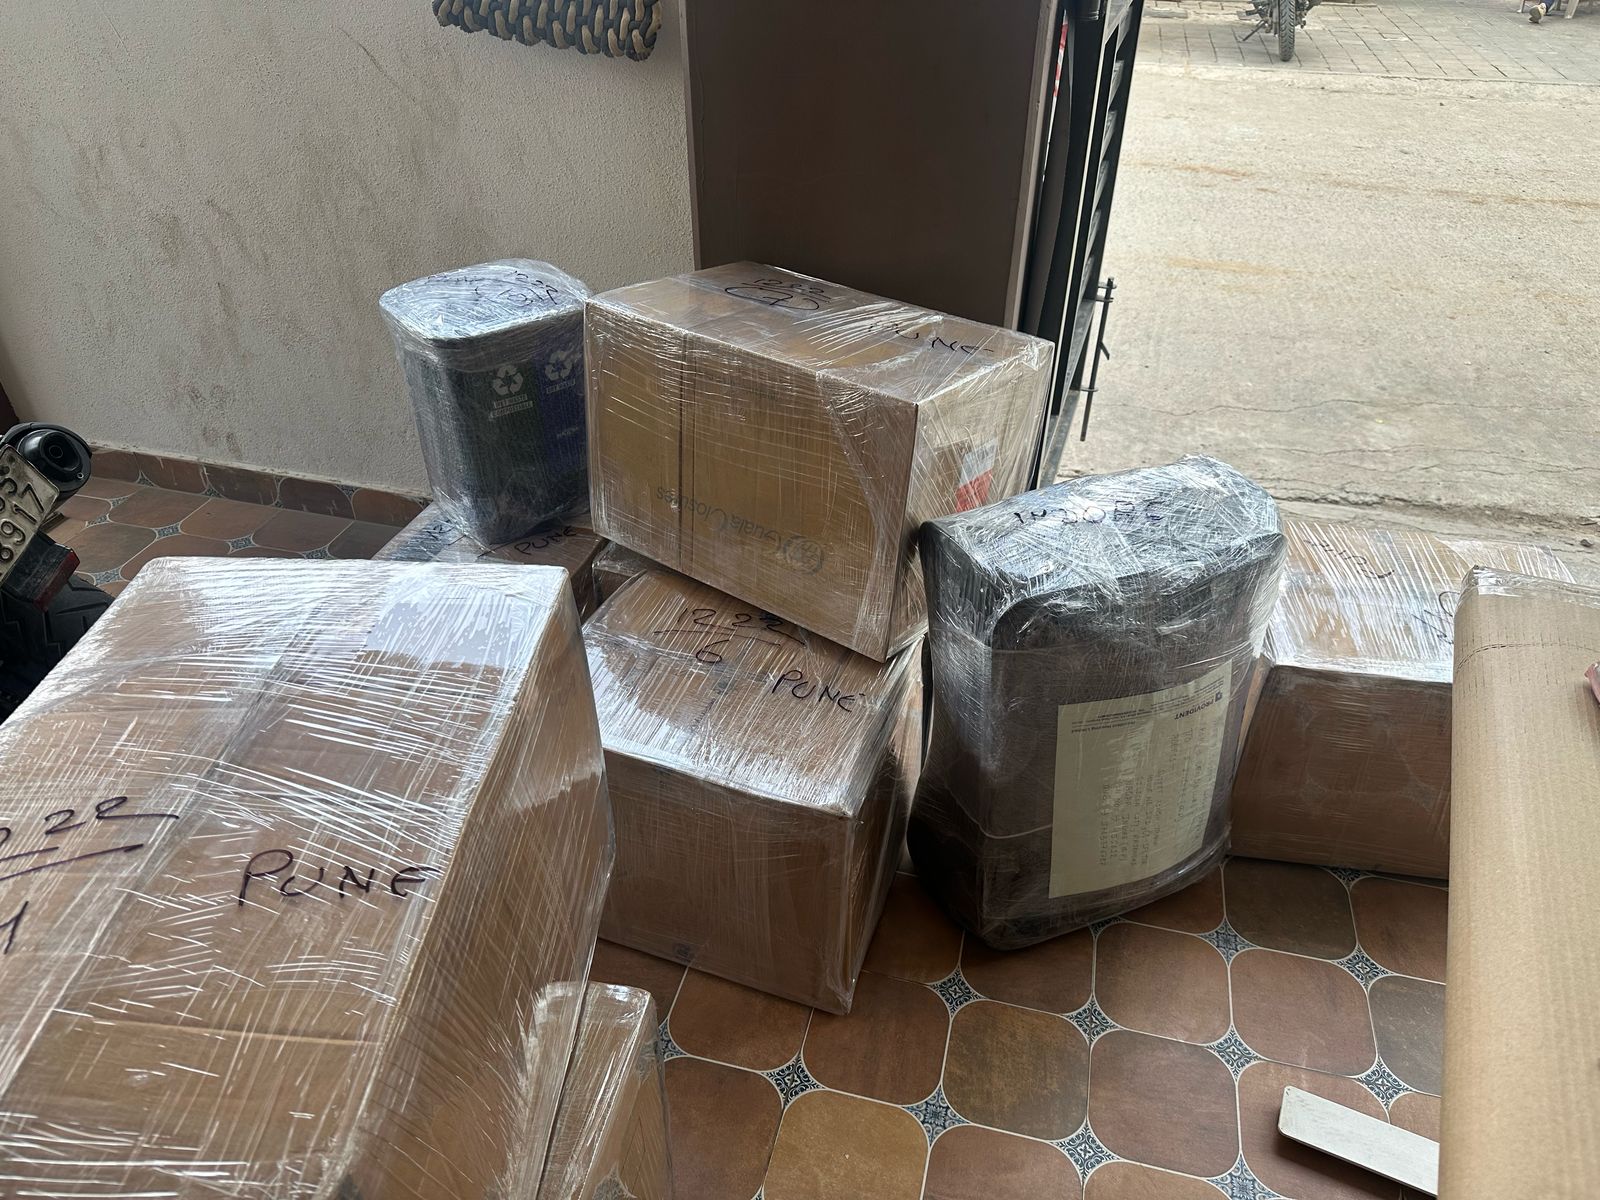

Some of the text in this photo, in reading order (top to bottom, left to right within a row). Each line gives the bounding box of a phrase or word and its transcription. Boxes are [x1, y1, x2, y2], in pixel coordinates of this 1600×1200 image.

[868, 322, 994, 356] UNE
[771, 669, 867, 713] PUNE
[238, 849, 438, 907] PUNE
